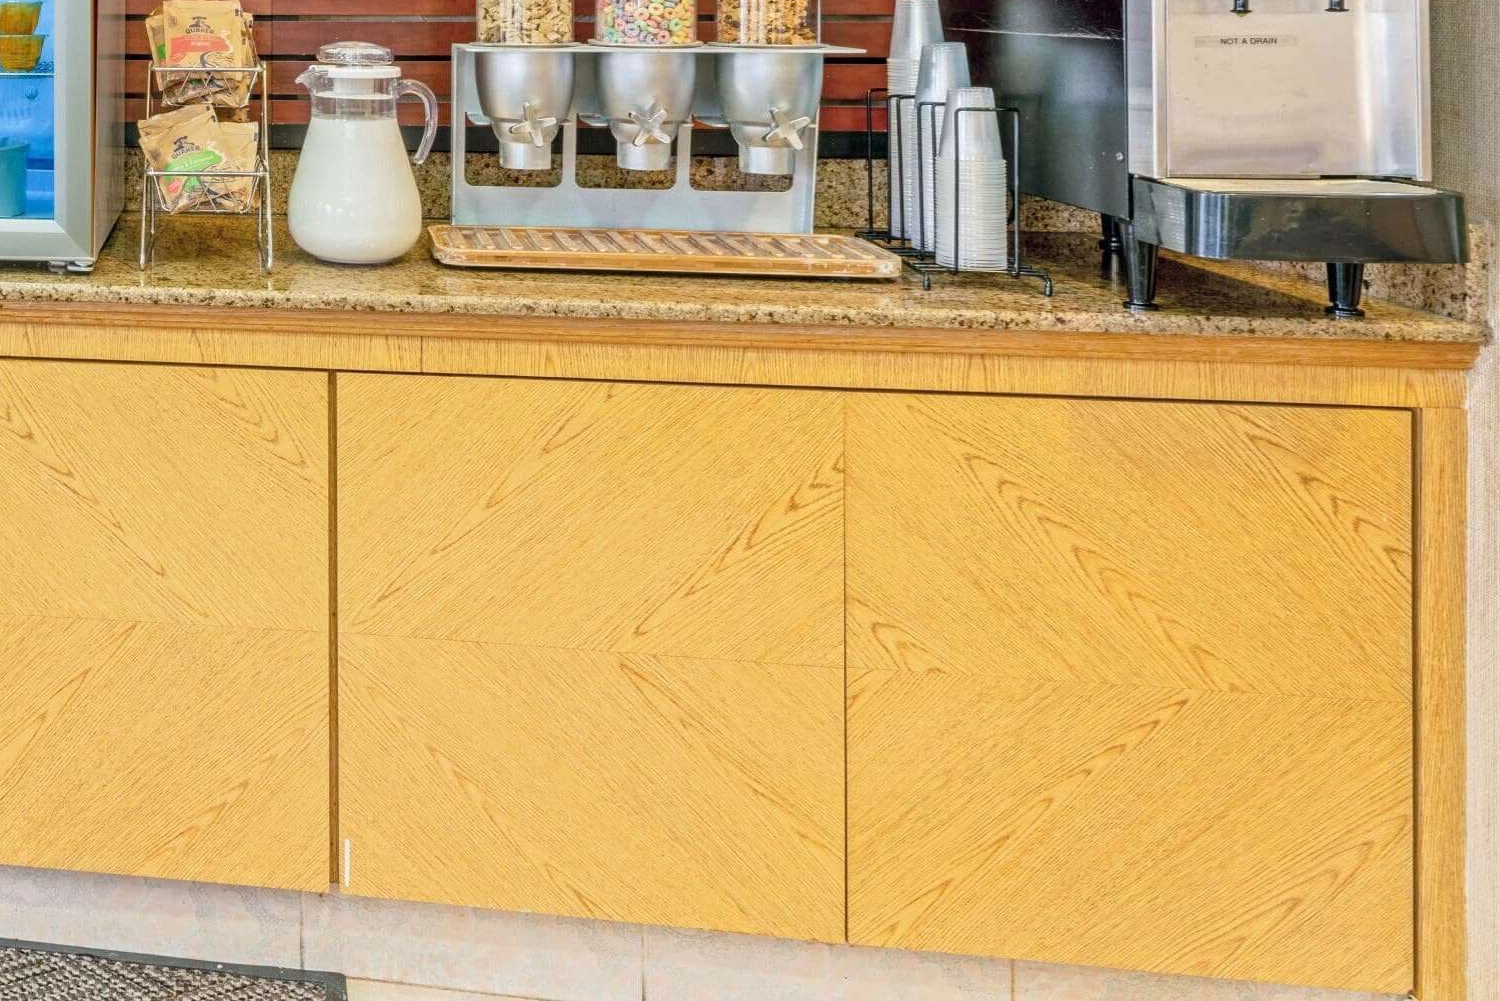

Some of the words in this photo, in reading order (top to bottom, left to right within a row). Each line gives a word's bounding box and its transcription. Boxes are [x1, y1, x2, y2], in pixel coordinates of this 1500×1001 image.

[1220, 37, 1238, 45] NOT
[1241, 37, 1248, 45] A
[1250, 37, 1278, 45] DRAIN
